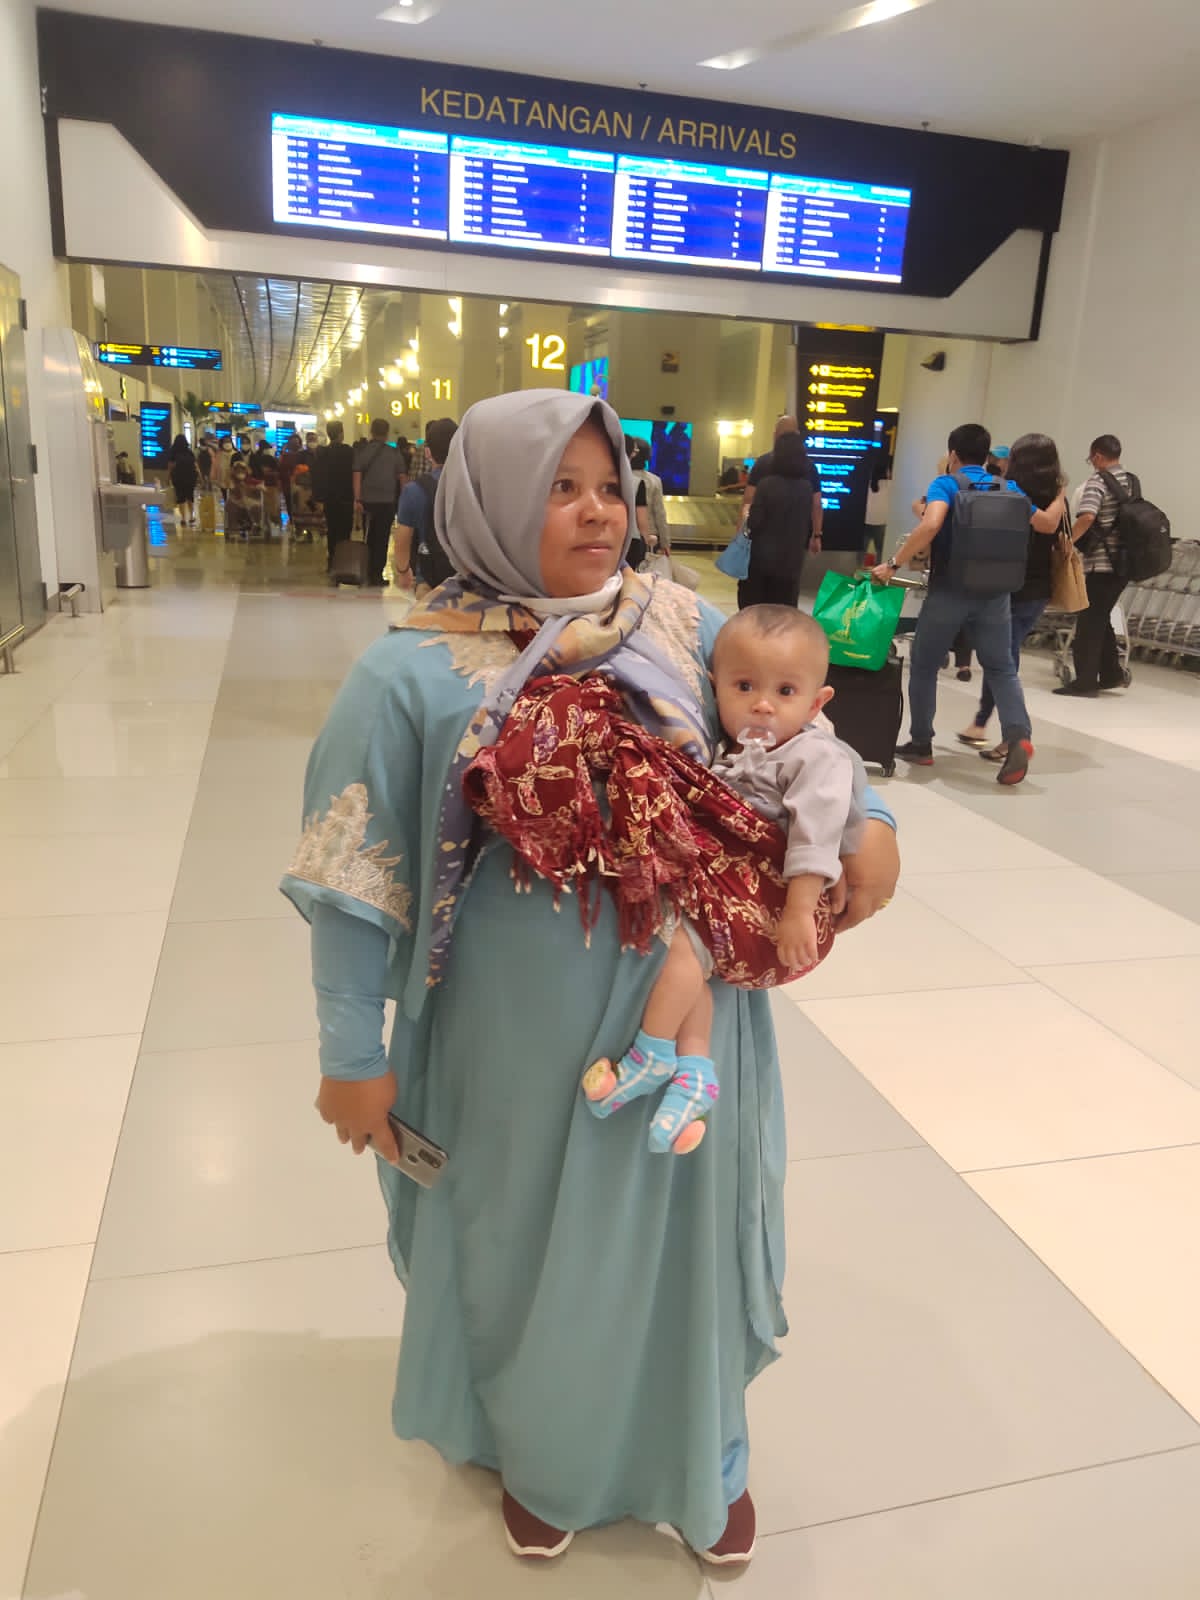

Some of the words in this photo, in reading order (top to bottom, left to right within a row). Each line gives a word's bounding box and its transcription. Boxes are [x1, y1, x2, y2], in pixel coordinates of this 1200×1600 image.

[420, 87, 633, 140] KEDATANGAN
[640, 115, 652, 141] /
[657, 117, 797, 159] ARRIVALS
[526, 333, 565, 370] 12
[431, 378, 451, 400] 11
[355, 412, 363, 425] 7
[390, 400, 403, 416] 9
